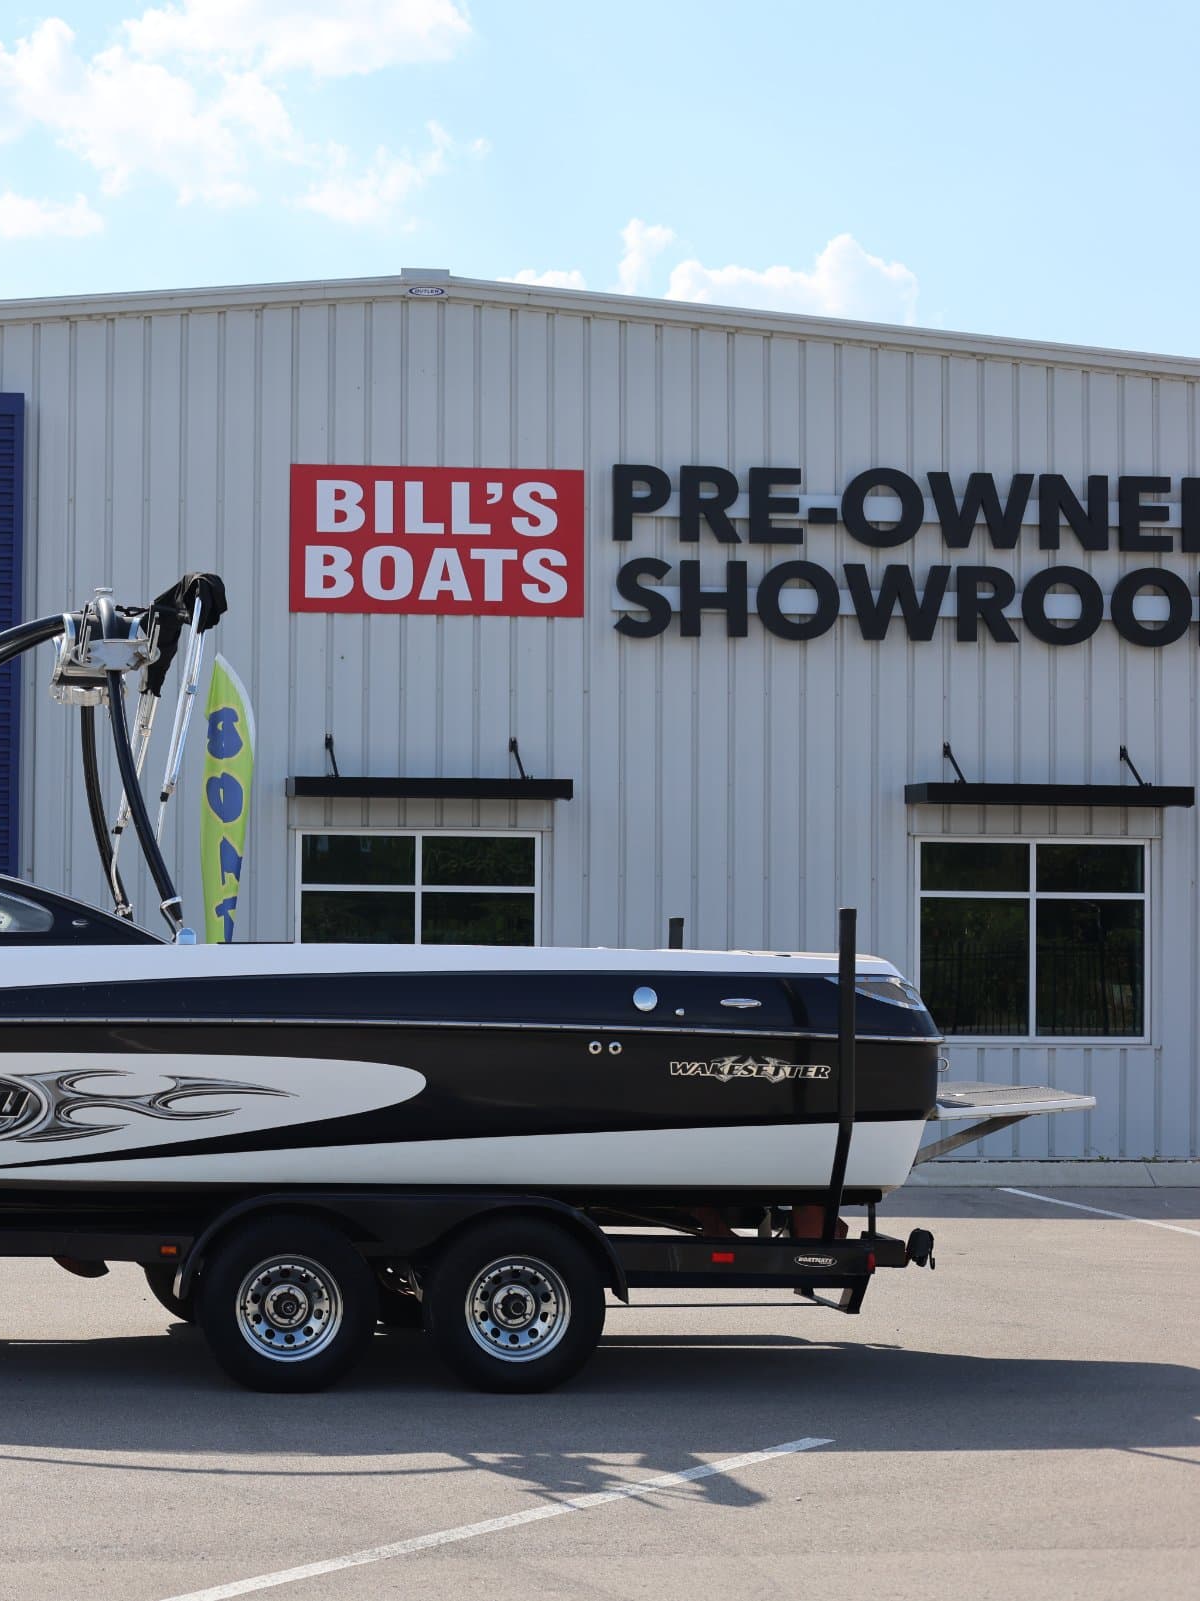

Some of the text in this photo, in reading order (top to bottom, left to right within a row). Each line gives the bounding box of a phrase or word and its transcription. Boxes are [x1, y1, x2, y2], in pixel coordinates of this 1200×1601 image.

[316, 479, 558, 537] BILL'S
[612, 463, 1200, 553] PRE-OWNE
[304, 545, 568, 604] BOATS
[613, 557, 1200, 648] SHOWROO
[670, 1061, 831, 1079] WAKESETTER
